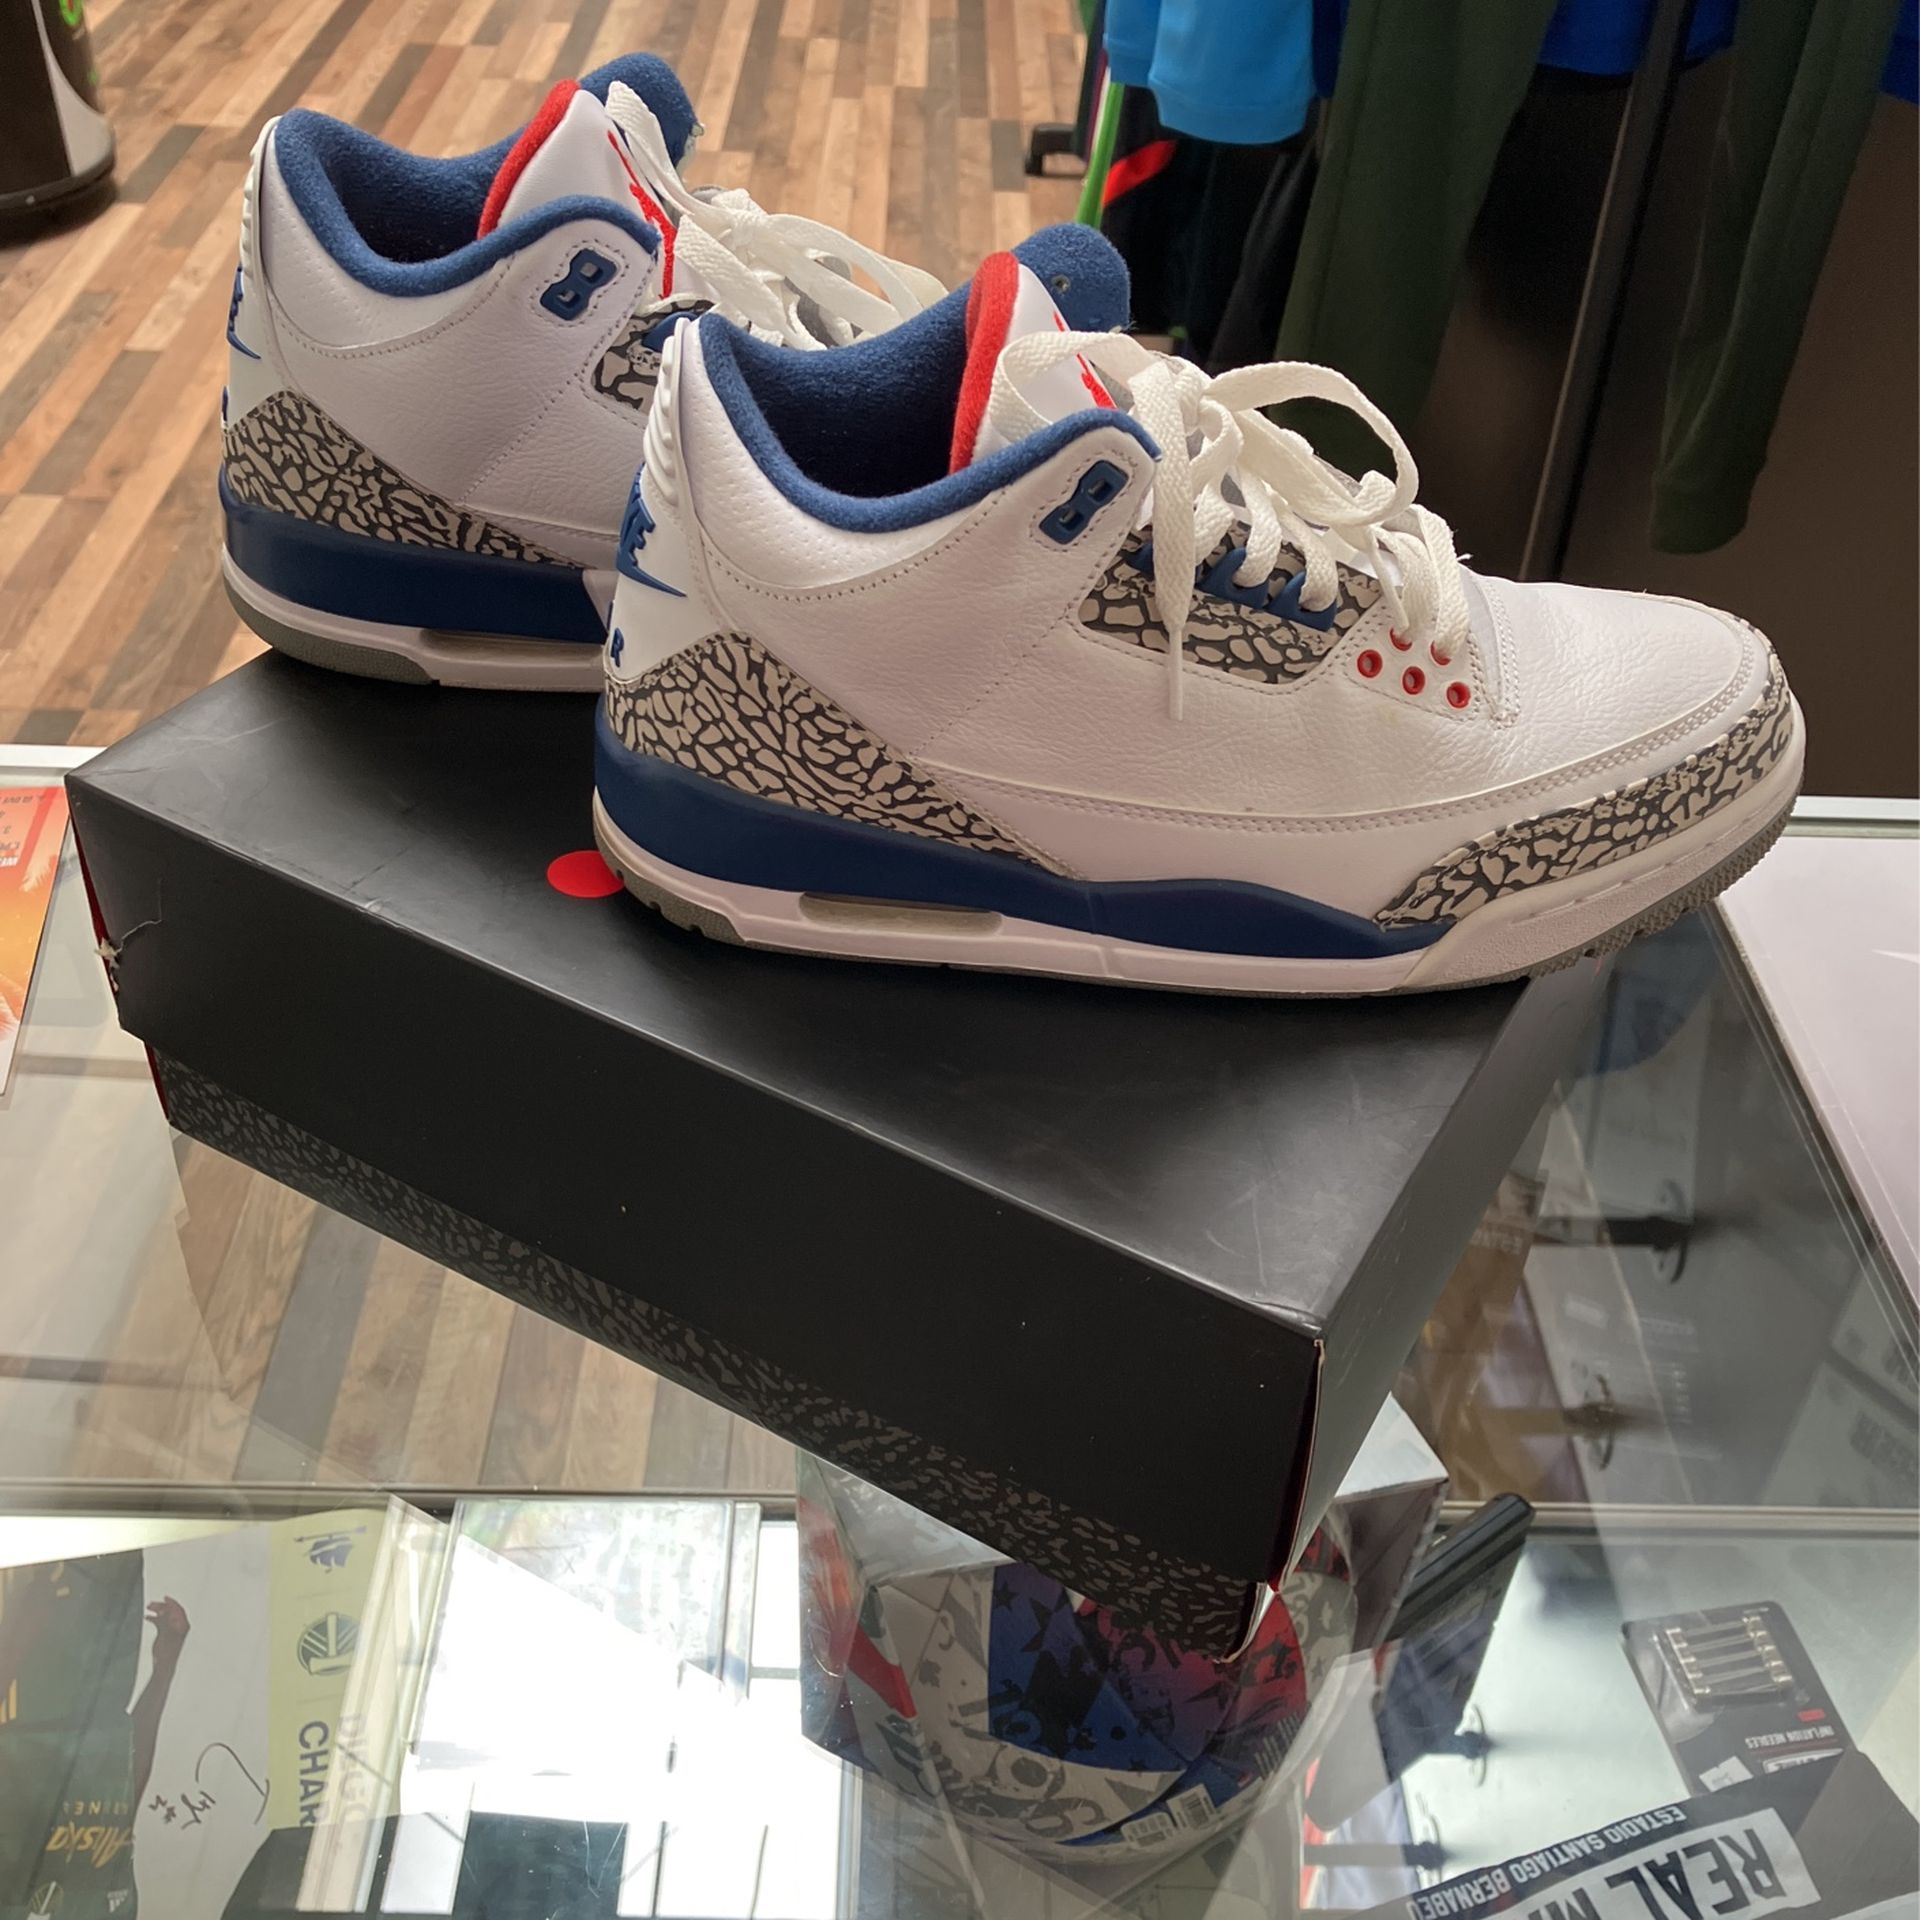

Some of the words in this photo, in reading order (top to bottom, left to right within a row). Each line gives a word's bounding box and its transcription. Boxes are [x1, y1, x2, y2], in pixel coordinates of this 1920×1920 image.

[1745, 1733, 1786, 1749] NEEDLES
[1787, 1725, 1834, 1742] INFLATION
[1603, 1806, 1686, 1843] ESTADIO
[1509, 1833, 1606, 1883] SANTIAGO
[1604, 1829, 1787, 1920] REAL
[1407, 1867, 1512, 1920] BERNABEU
